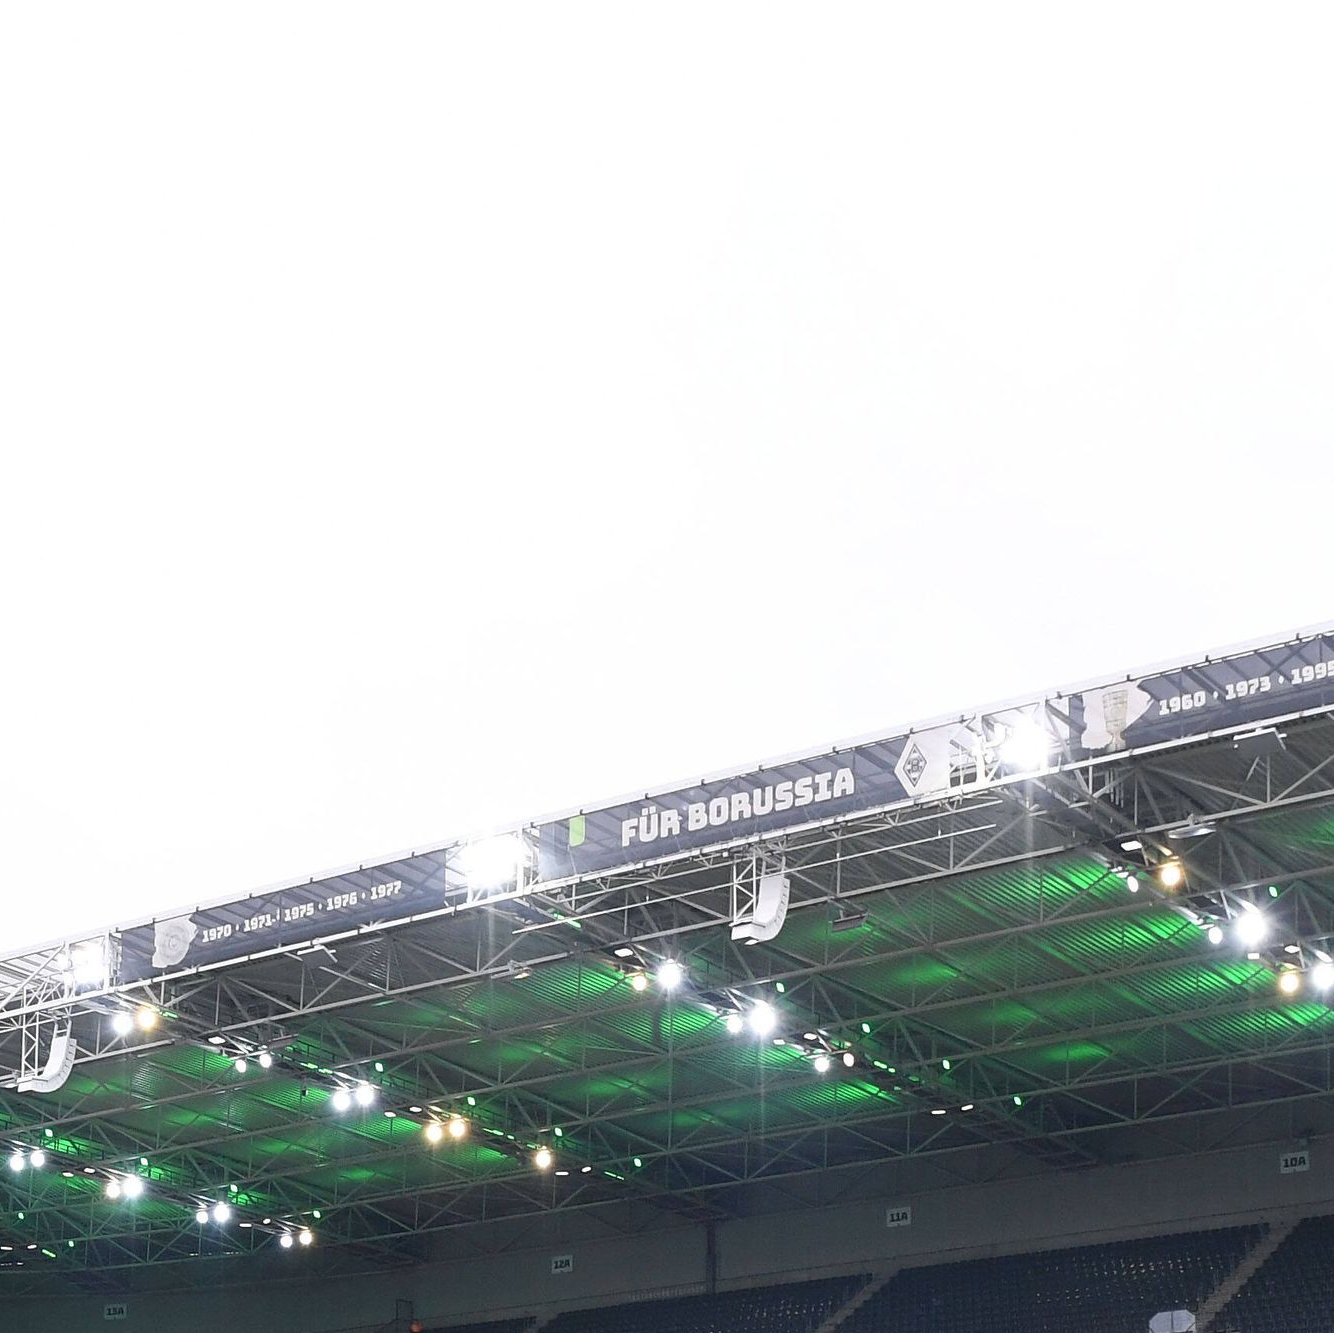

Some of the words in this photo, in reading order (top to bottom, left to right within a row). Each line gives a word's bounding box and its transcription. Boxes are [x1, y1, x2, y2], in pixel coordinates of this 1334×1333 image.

[1158, 690, 1206, 715] 1960
[1225, 676, 1271, 700] 1973
[621, 806, 681, 847] FÜR
[687, 767, 855, 832] BORUSSIA
[202, 924, 231, 943] 1970
[284, 903, 314, 921] 1975
[326, 892, 357, 910] 1976
[370, 881, 402, 900] 1977
